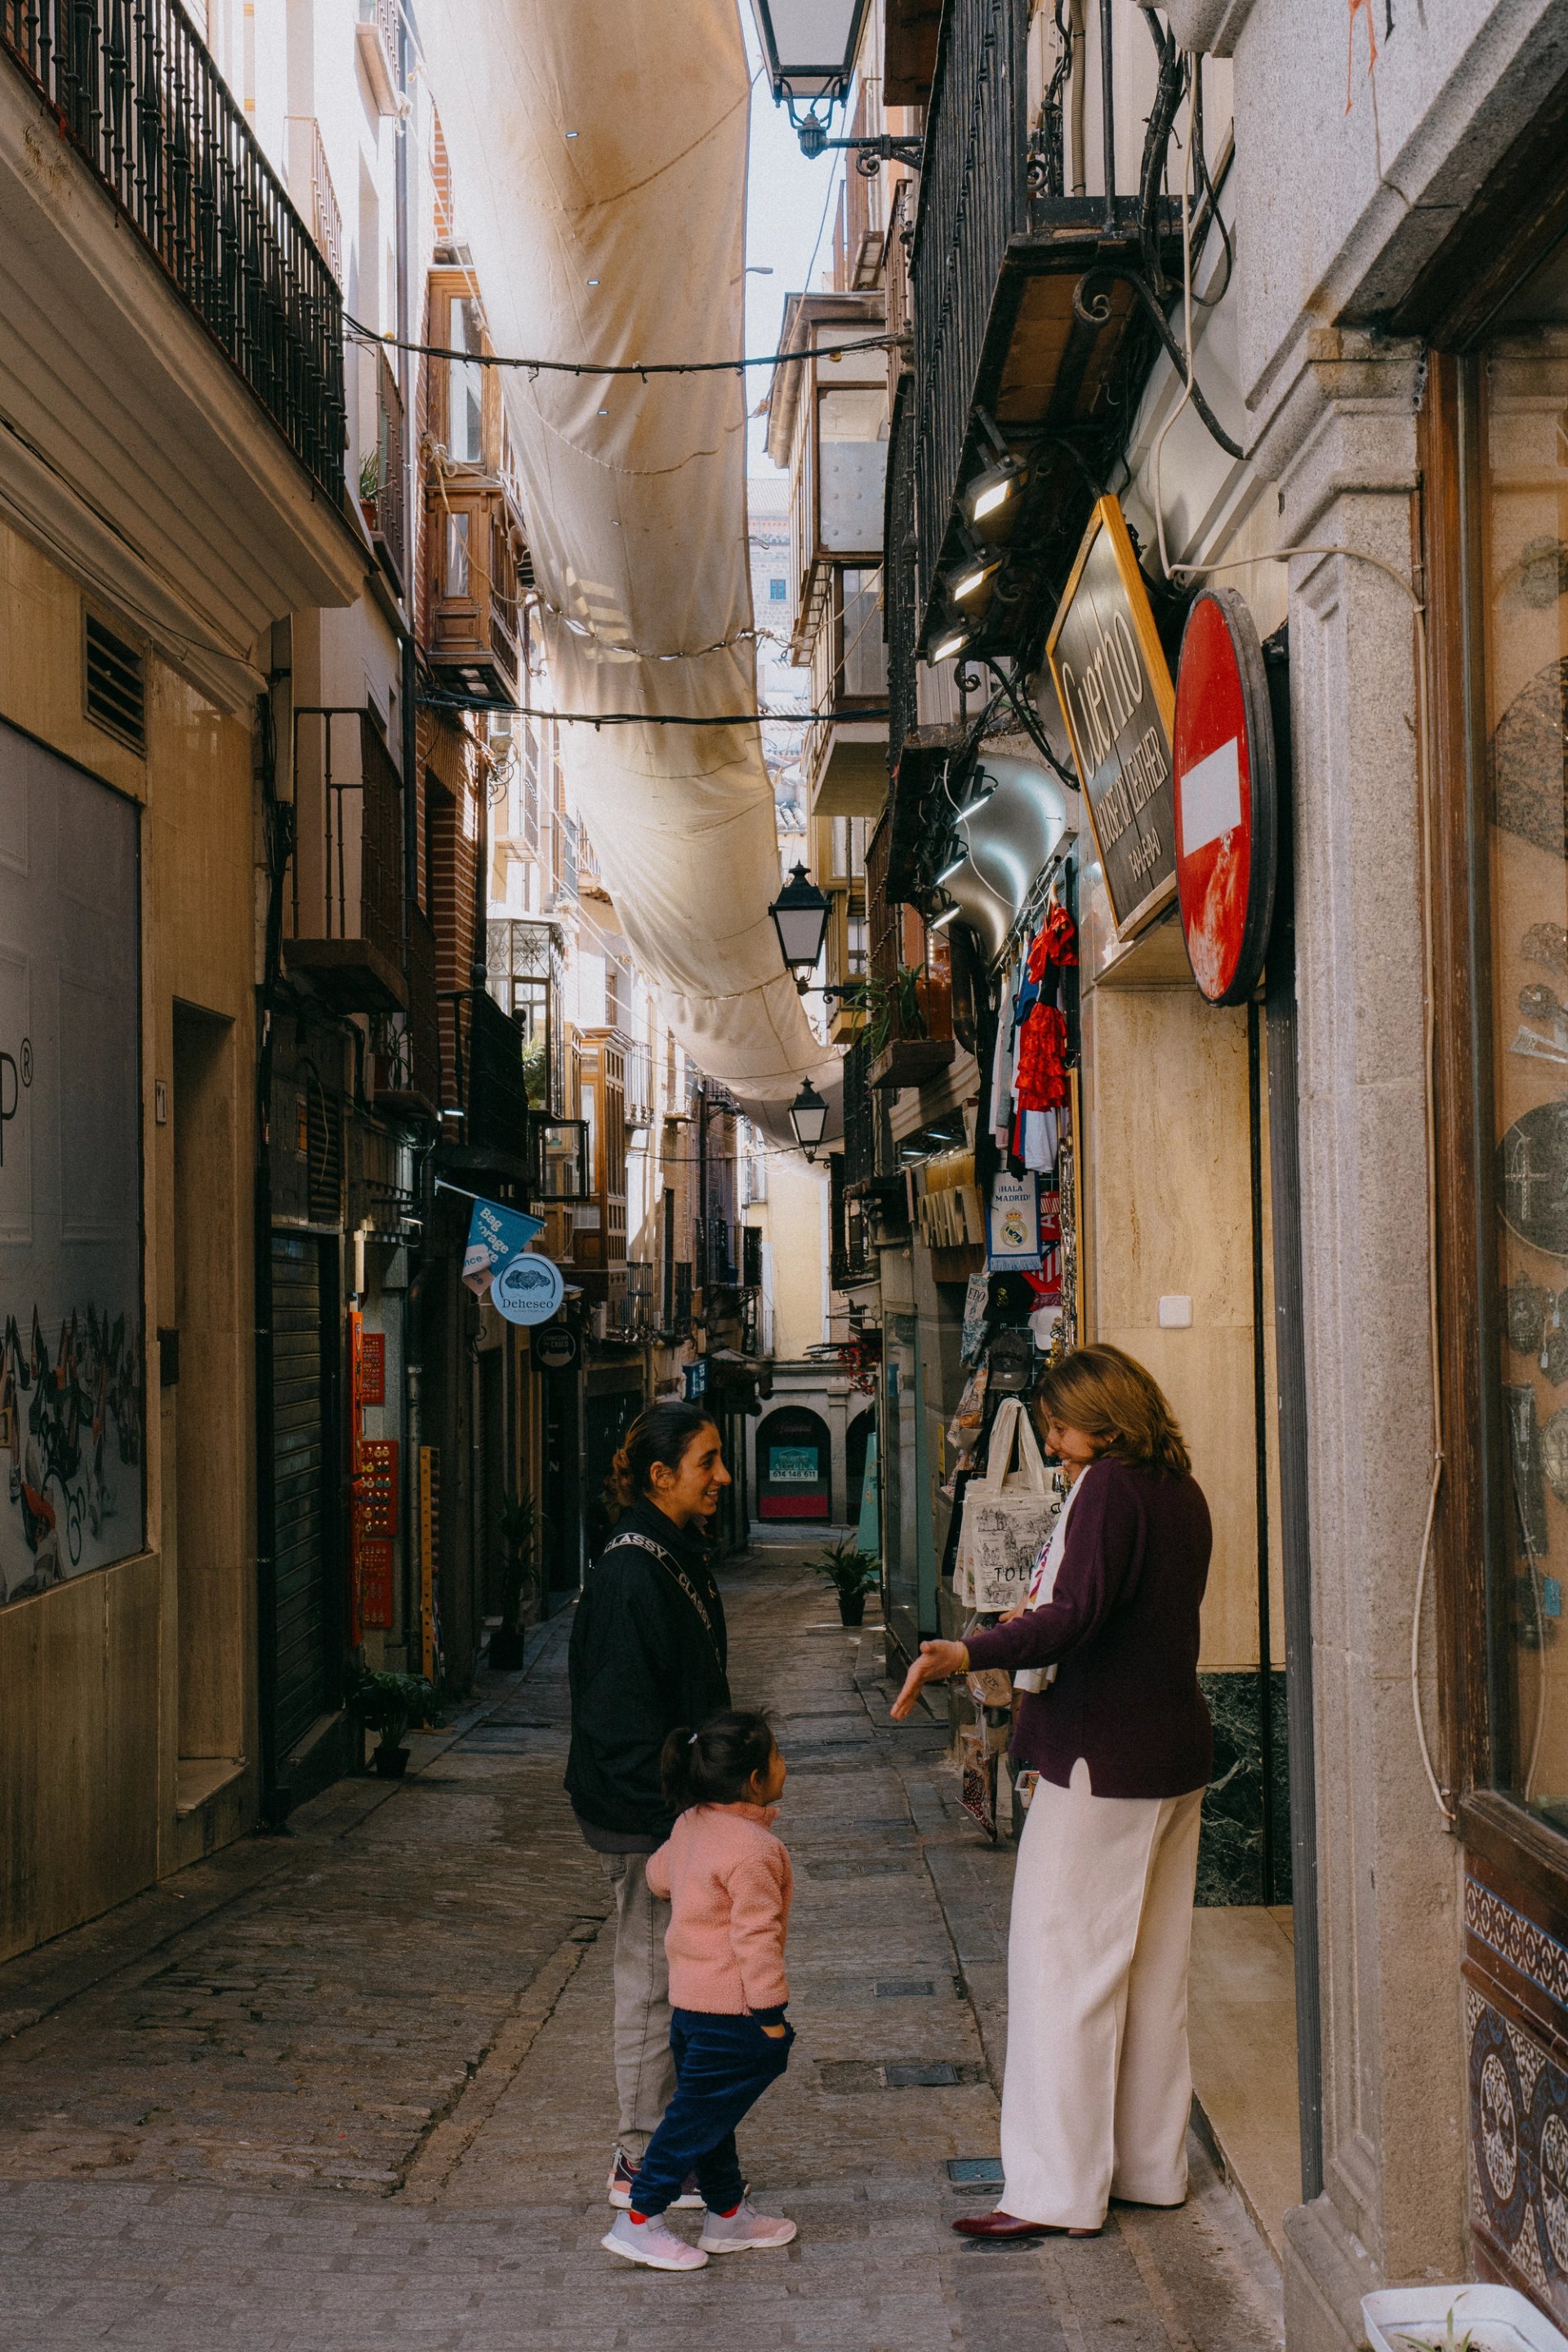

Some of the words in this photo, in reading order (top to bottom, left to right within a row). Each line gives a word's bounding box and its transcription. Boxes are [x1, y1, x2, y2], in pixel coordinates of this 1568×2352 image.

[1123, 725, 1169, 816] LEATHER
[1094, 784, 1125, 855] HOUSE
[1115, 773, 1134, 827] OF
[478, 1221, 510, 1254] orage
[479, 1207, 503, 1232] Bag
[501, 1298, 555, 1308] Deheseo
